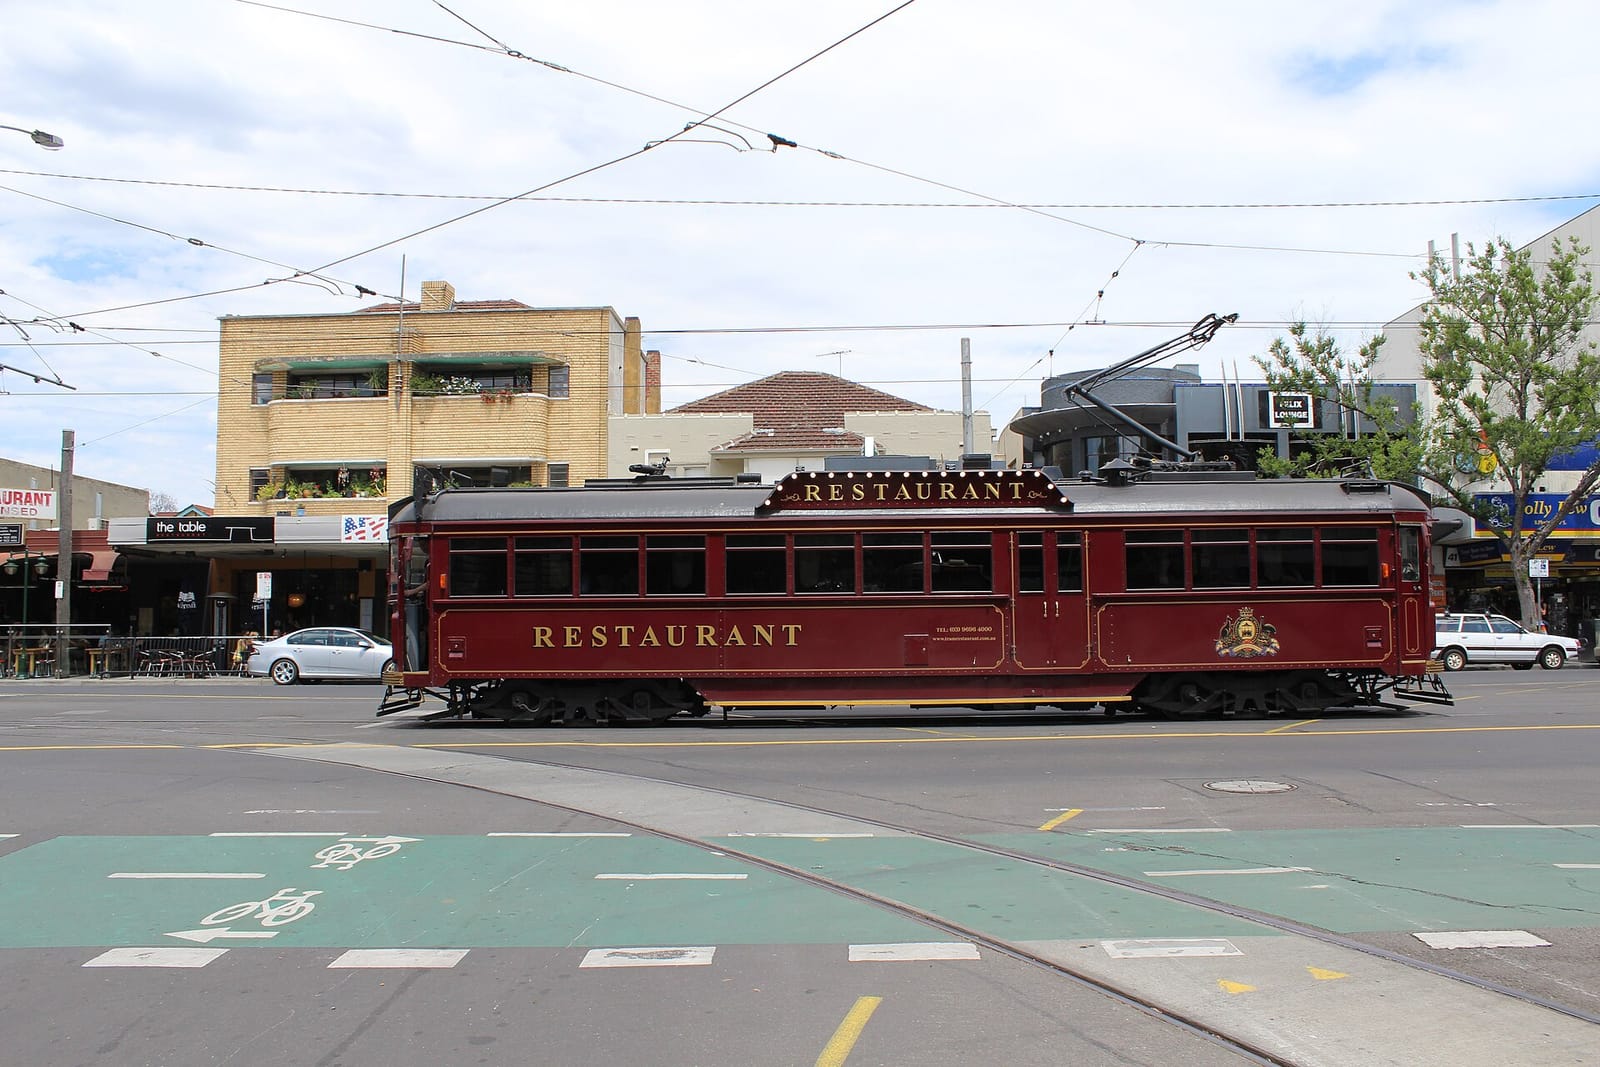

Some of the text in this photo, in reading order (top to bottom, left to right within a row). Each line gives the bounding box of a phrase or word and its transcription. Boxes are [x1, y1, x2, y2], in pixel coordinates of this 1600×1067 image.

[0, 490, 52, 507] URANT
[804, 482, 1025, 501] RESTAURANT
[1524, 500, 1552, 518] olly
[156, 521, 206, 532] the table
[532, 624, 802, 648] RESTAURANT
